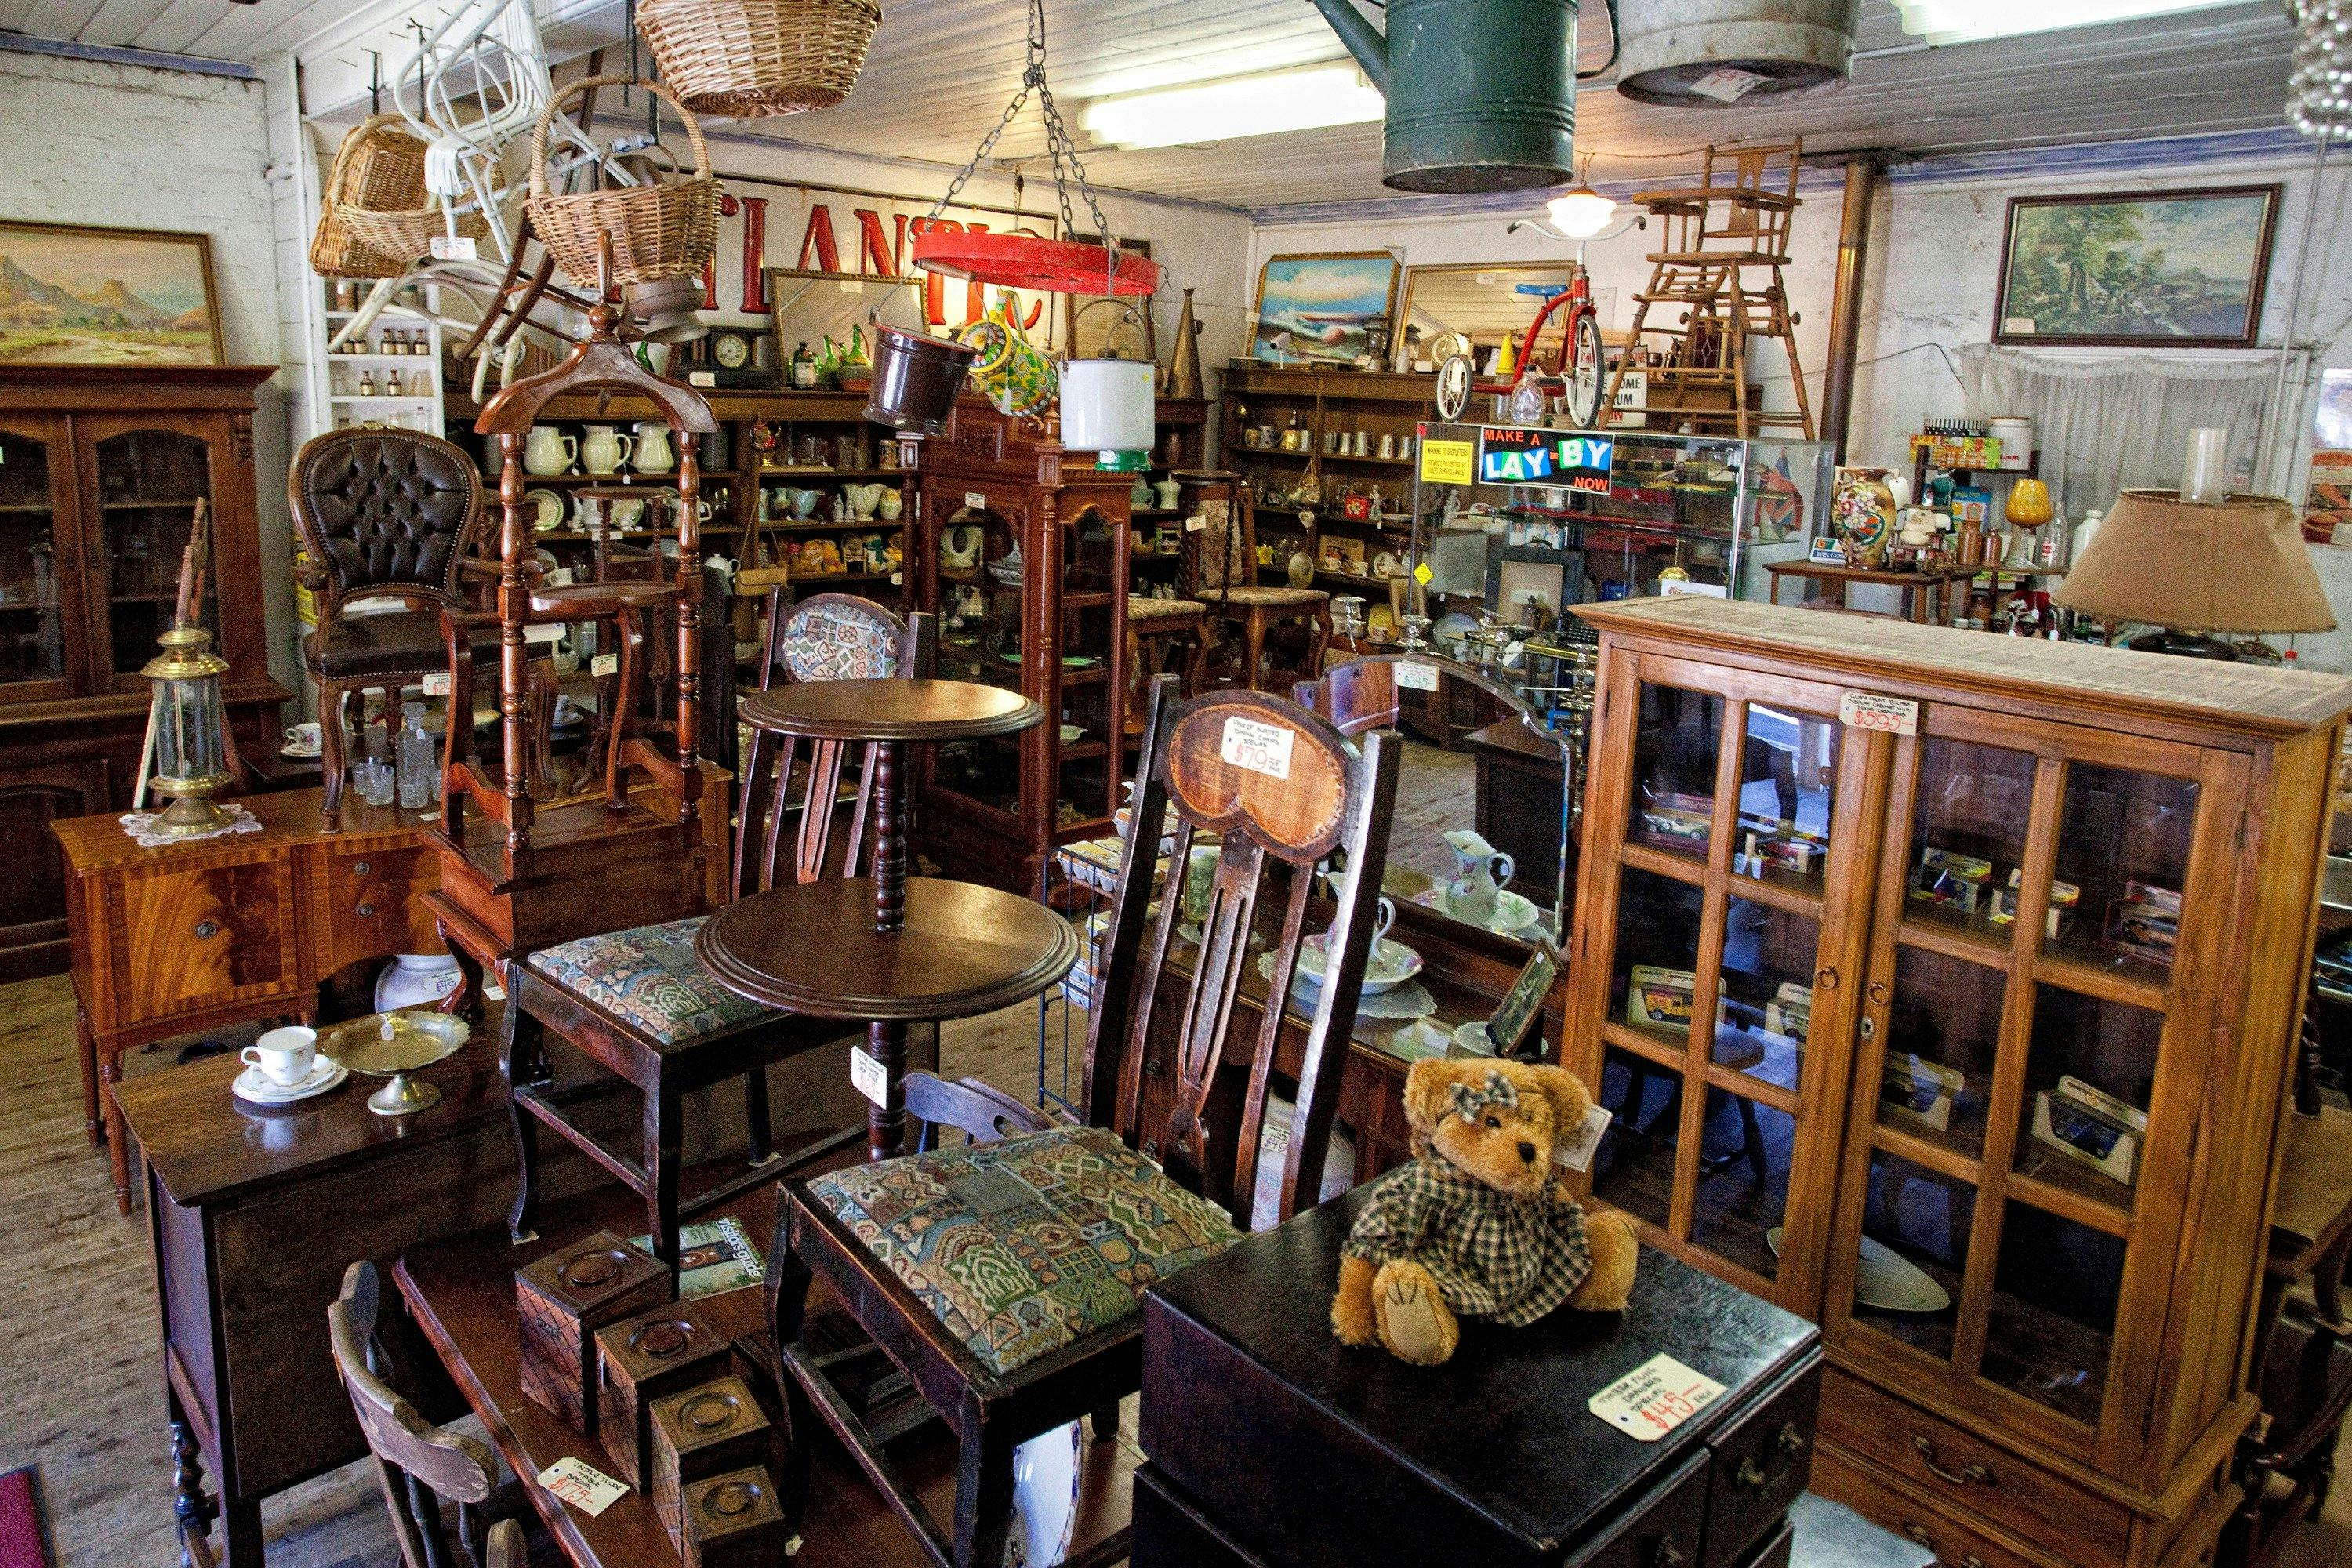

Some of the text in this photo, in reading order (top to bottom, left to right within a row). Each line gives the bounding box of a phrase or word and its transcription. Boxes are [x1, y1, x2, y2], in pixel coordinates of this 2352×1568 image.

[1613, 378, 1641, 389] OME
[1484, 430, 1541, 445] MAKE A
[1485, 438, 1611, 479] LAY-BY
[1574, 477, 1608, 491] NOW
[573, 1461, 601, 1479] VINTAGE
[578, 1471, 603, 1488] TABLE
